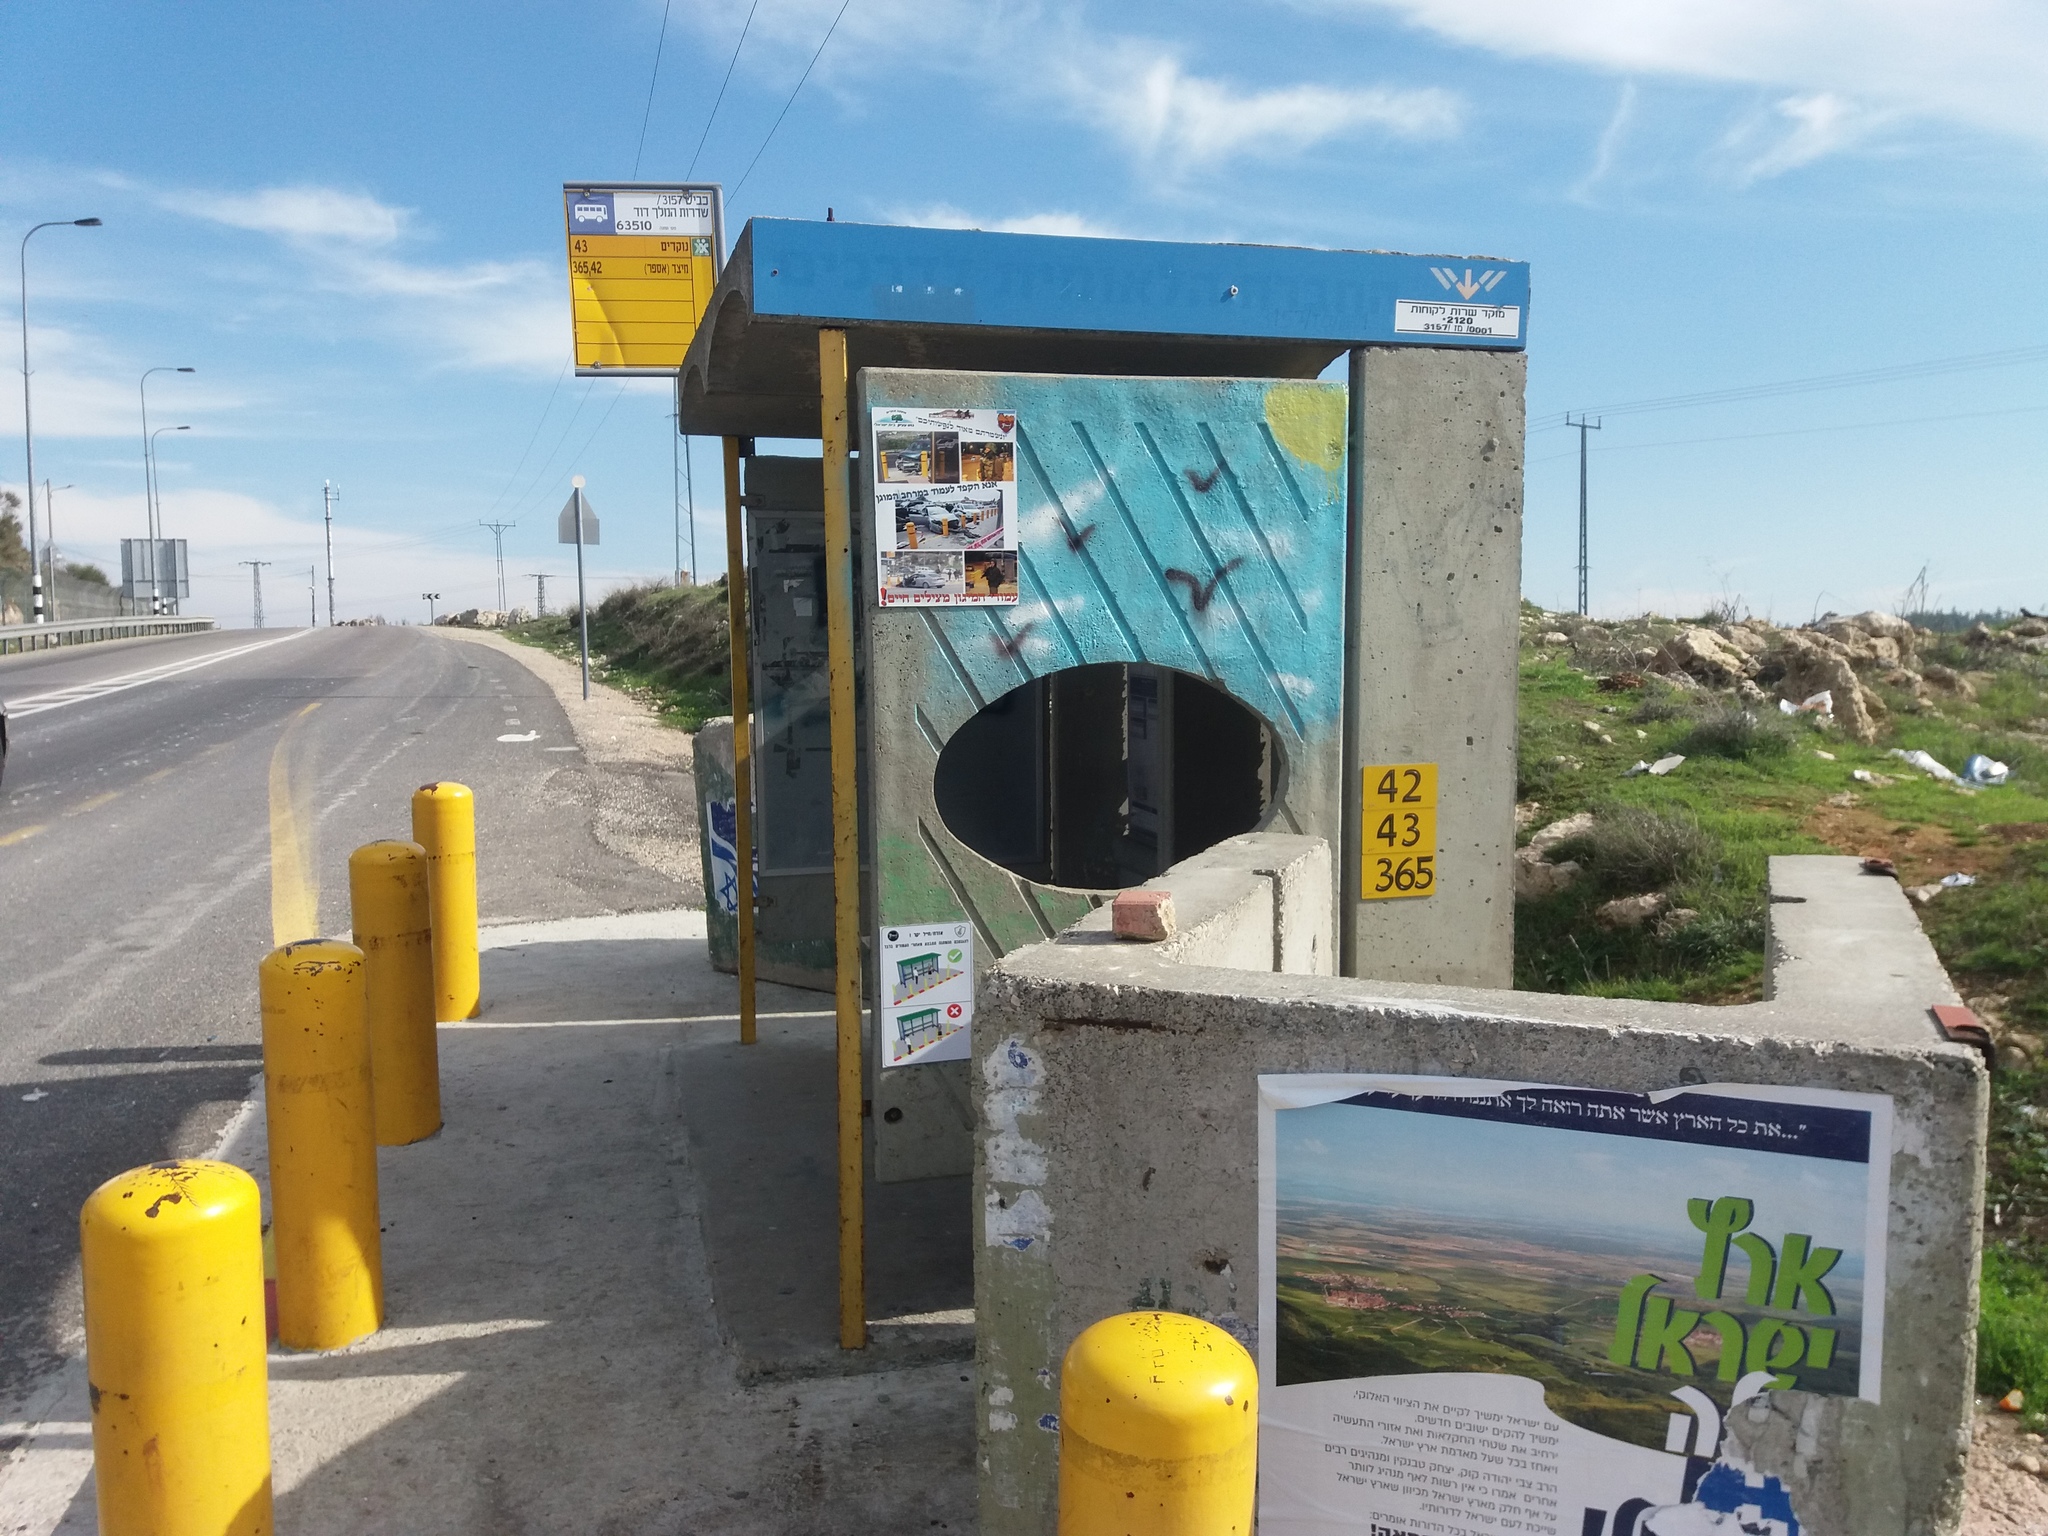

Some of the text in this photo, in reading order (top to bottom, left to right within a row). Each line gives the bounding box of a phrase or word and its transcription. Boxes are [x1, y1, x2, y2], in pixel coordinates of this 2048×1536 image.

[662, 194, 683, 205] 3157
[633, 206, 709, 218] שדרות המלך דוד
[616, 220, 652, 231] 63510
[574, 240, 689, 253] נוקדים 43
[572, 261, 689, 276] מיצד (אספר) 365,42
[1410, 305, 1505, 318] מוקד שרות לקוחות
[930, 486, 954, 496] לעמוד
[958, 483, 979, 493] הקפד
[876, 492, 899, 504] המוגן
[901, 490, 929, 499] במרחב
[880, 586, 1018, 606] עמודי המיגון מצילים חיים!
[1377, 768, 1422, 803] 42
[1376, 812, 1420, 847] 43
[1375, 856, 1433, 892] 365
[1516, 1095, 1537, 1113] לך
[1542, 1098, 1582, 1116] רואה
[1587, 1102, 1625, 1120] אתה
[1629, 1107, 1668, 1124] אשר
[1674, 1111, 1722, 1131] הארץ
[1727, 1116, 1748, 1134] כל
[1686, 1196, 1844, 1316] ארץ
[1608, 1274, 1840, 1390] ישראל
[1393, 1396, 1420, 1408] הציווי
[1424, 1402, 1439, 1412] את
[1443, 1405, 1470, 1417] לקיים
[1474, 1410, 1503, 1422] ימשיך
[1455, 1421, 1488, 1433] ישובים
[1506, 1414, 1540, 1428] ישראל
[1544, 1422, 1559, 1431] עם
[1333, 1414, 1558, 1459] ירחיב את שטחי החקלאות ואת אזורי התעשיה
[1492, 1428, 1525, 1439] להקים
[1529, 1433, 1559, 1445] ימשיך
[1325, 1444, 1346, 1454] רבים
[1417, 1442, 1437, 1452] ארץ
[1441, 1446, 1478, 1460] מאדמת
[1350, 1448, 1390, 1462] ומנהיגים
[1481, 1452, 1503, 1464] שעל
[1393, 1456, 1425, 1468] טבנקין
[1429, 1462, 1454, 1474] יצחק
[1507, 1457, 1527, 1468] בכל
[1531, 1461, 1558, 1474] ויאחז
[1348, 1461, 1557, 1507] אחרים אמרו כי אין רשות לאף מנהיג לוותר
[1483, 1472, 1512, 1484] יהודה
[1516, 1478, 1533, 1488] צבי
[1536, 1482, 1557, 1493] הרב
[1336, 1472, 1557, 1521] על אף חלק מארץ ישראל מכיוון שארץ ישראל
[1465, 1510, 1497, 1524] ישראל
[1501, 1518, 1522, 1528] לעם
[1410, 1518, 1444, 1532] הדורות
[1526, 1522, 1556, 1535] שייכת
